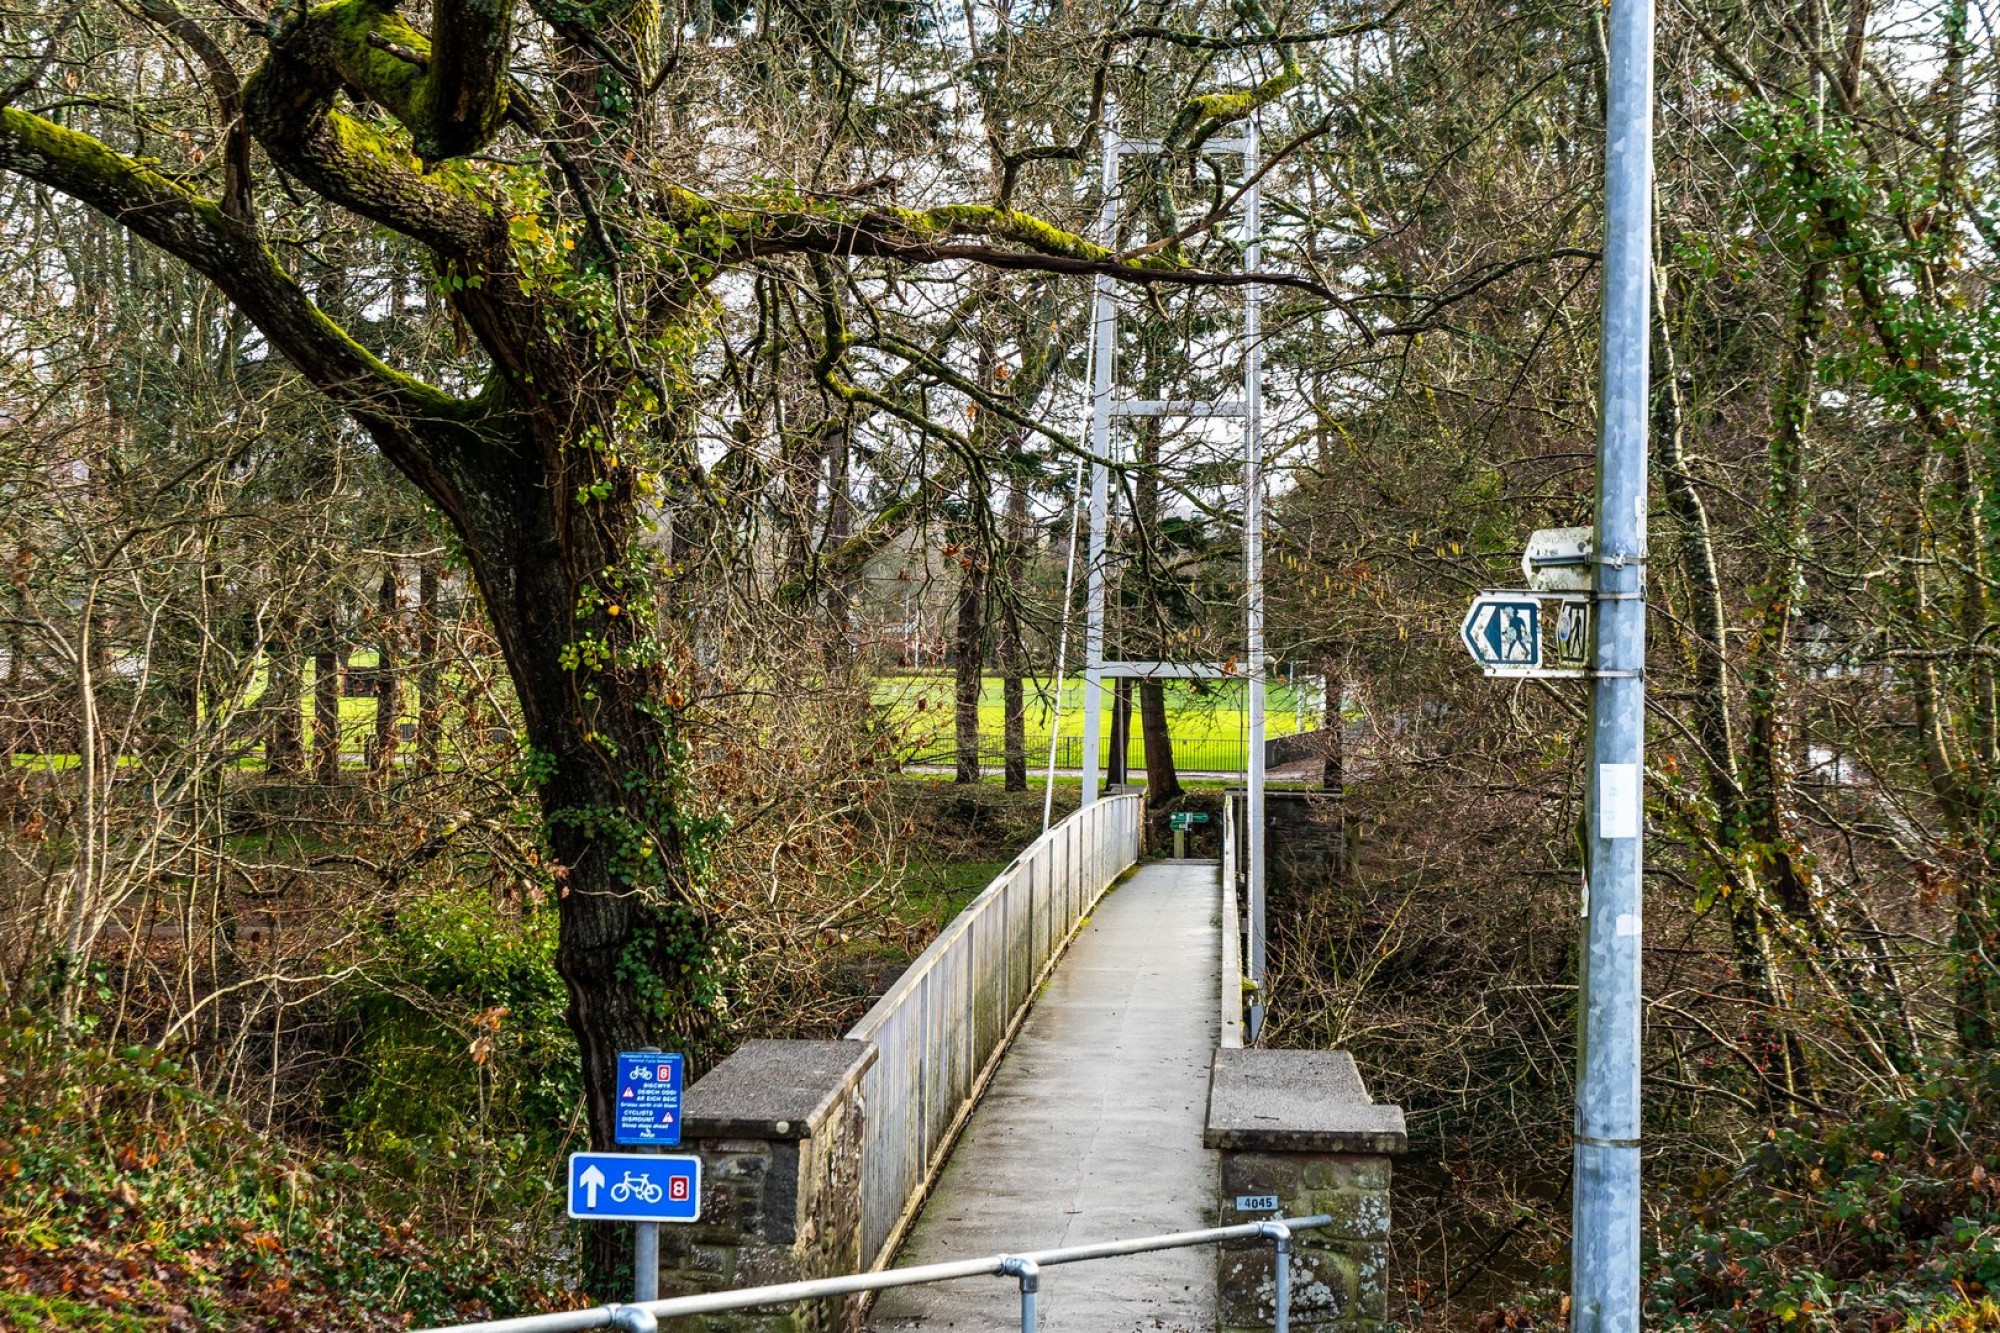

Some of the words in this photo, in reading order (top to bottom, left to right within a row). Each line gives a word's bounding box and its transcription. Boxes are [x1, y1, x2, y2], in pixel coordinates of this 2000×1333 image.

[660, 1068, 667, 1078] 8
[673, 1181, 685, 1197] 8
[1244, 1198, 1272, 1208] 4045
